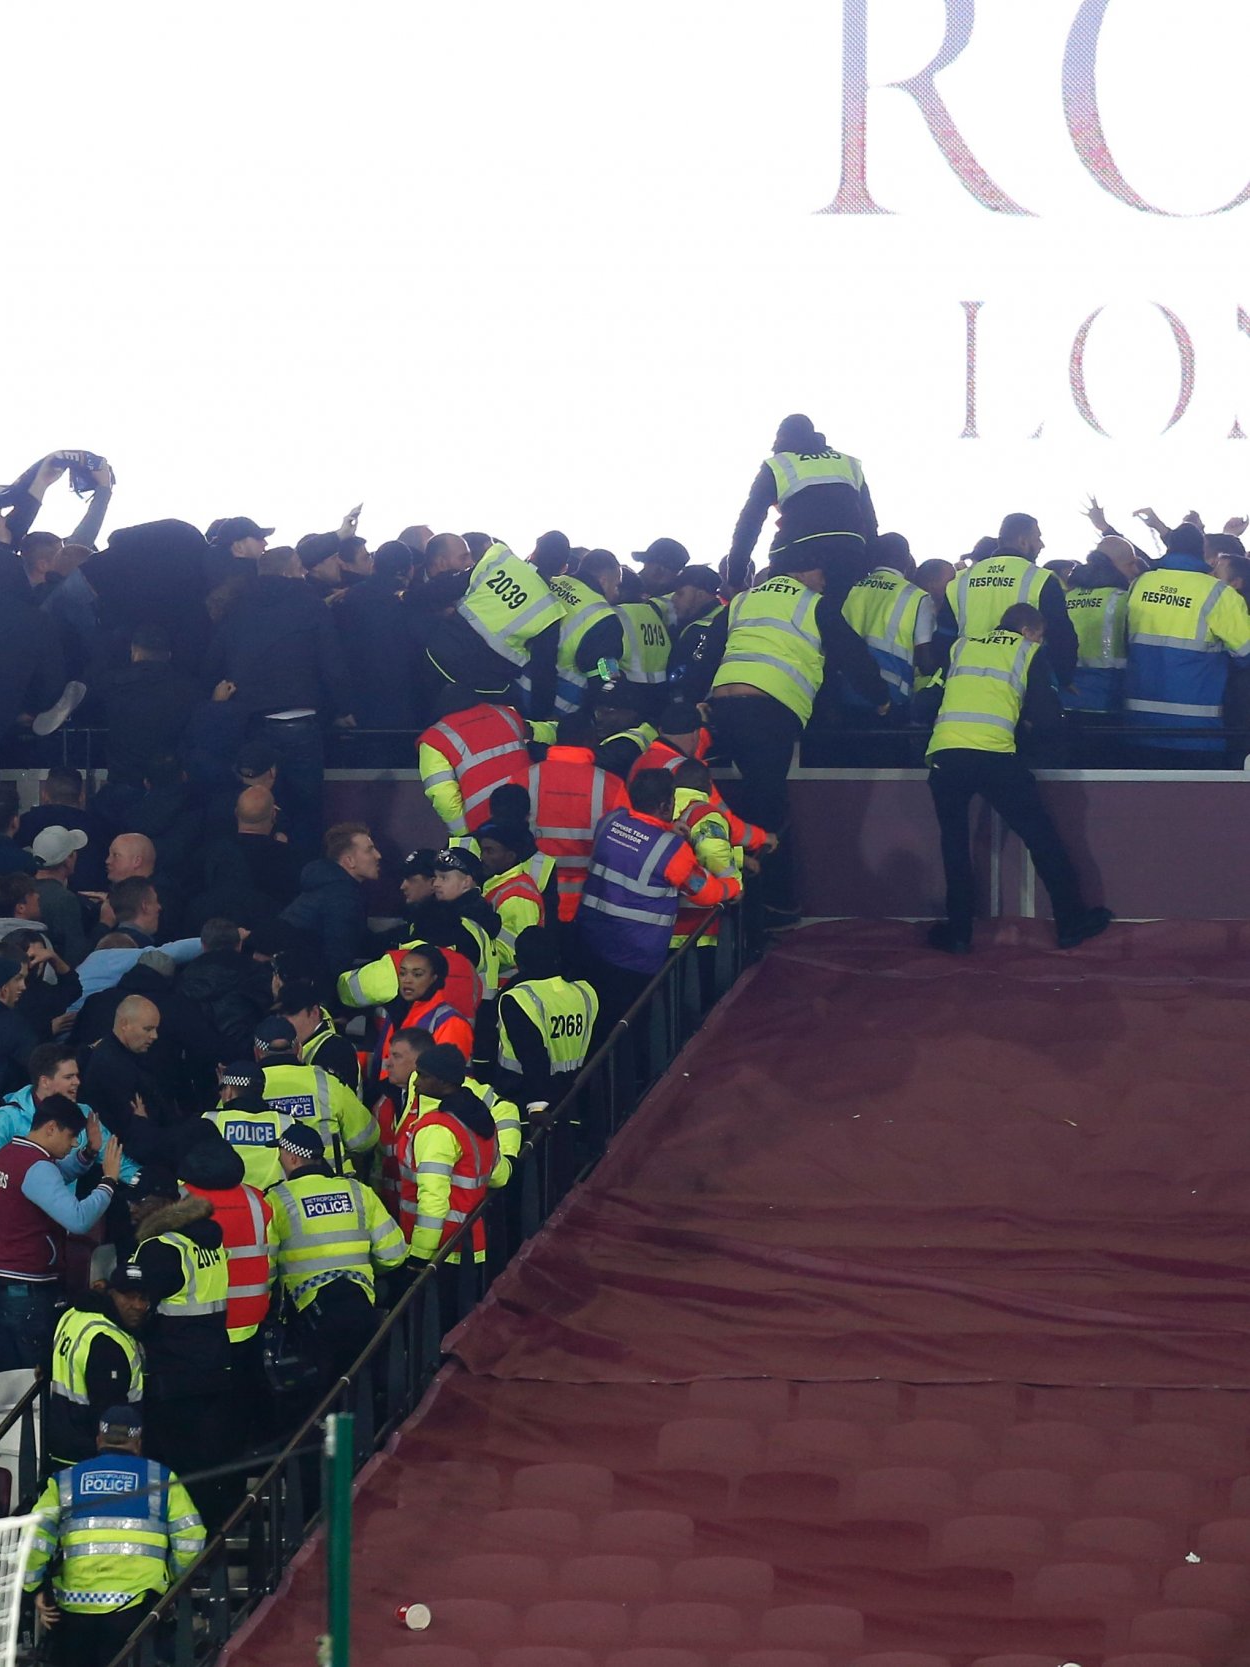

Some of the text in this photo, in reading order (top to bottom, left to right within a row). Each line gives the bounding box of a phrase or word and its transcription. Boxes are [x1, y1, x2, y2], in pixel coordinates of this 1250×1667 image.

[968, 576, 1016, 588] RESPONSE
[485, 569, 528, 610] 2039
[1159, 585, 1178, 594] 5889
[1065, 597, 1103, 610] ESPONSE
[1141, 591, 1192, 609] RESPONSE
[640, 623, 666, 647] 2019
[610, 827, 642, 844] SUPERVISOR
[633, 829, 650, 842] TEAM
[550, 1013, 583, 1039] 2068
[267, 1097, 311, 1107] ETROPOLITAN
[226, 1124, 274, 1142] POLICE
[304, 1194, 348, 1205] METROPOLITAN
[306, 1200, 350, 1216] POLICE
[85, 1479, 134, 1491] POLICE
